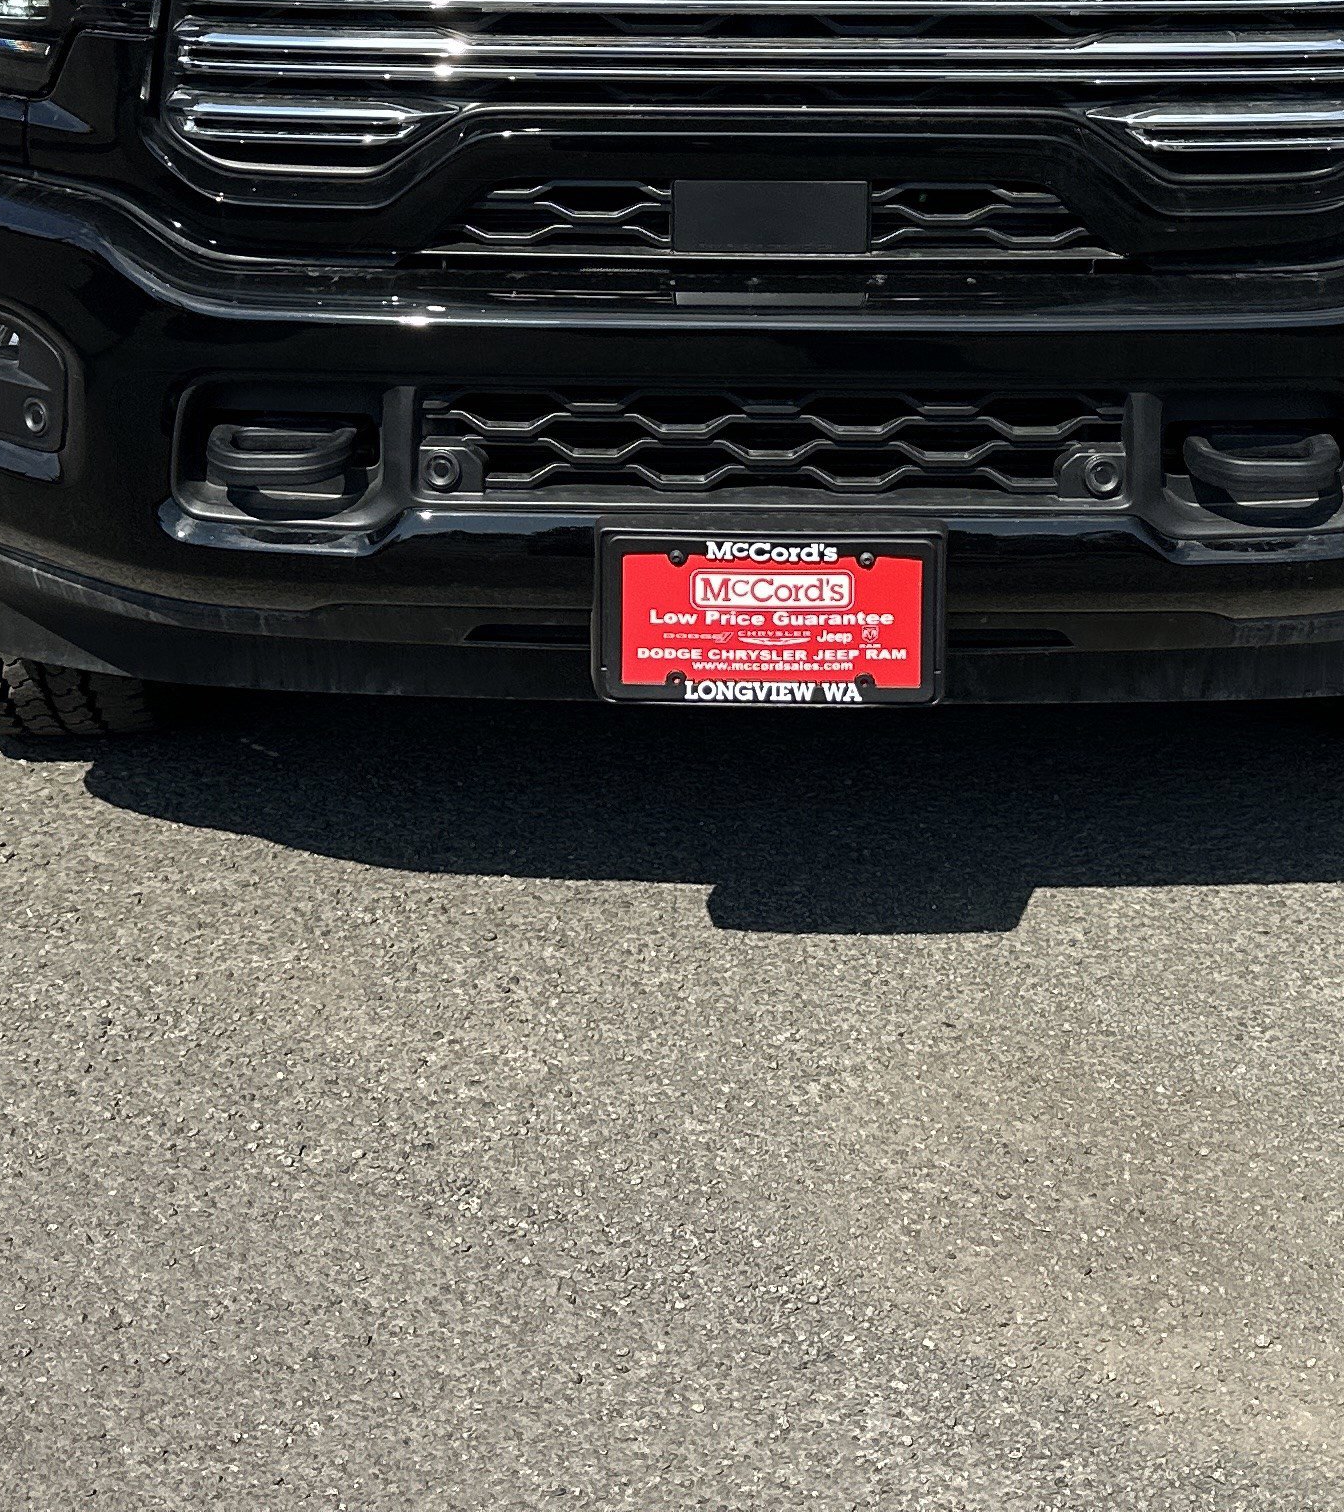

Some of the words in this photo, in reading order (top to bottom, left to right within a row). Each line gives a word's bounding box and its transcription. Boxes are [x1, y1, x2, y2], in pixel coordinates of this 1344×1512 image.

[705, 541, 838, 563] McCord's
[700, 577, 845, 603] McCord's
[649, 609, 696, 625] Low
[706, 610, 765, 626] Price
[772, 610, 894, 626] Guarantee
[737, 630, 812, 638] CHRYSLER
[816, 630, 852, 644] Jeep
[637, 648, 702, 659] DODGE
[707, 649, 807, 661] CHRYSLER
[813, 649, 859, 661] JEEP
[865, 649, 907, 660] RAM
[691, 661, 853, 671] www.mccordsales.com
[684, 680, 815, 701] LONGVIEW
[821, 682, 862, 702] WA
